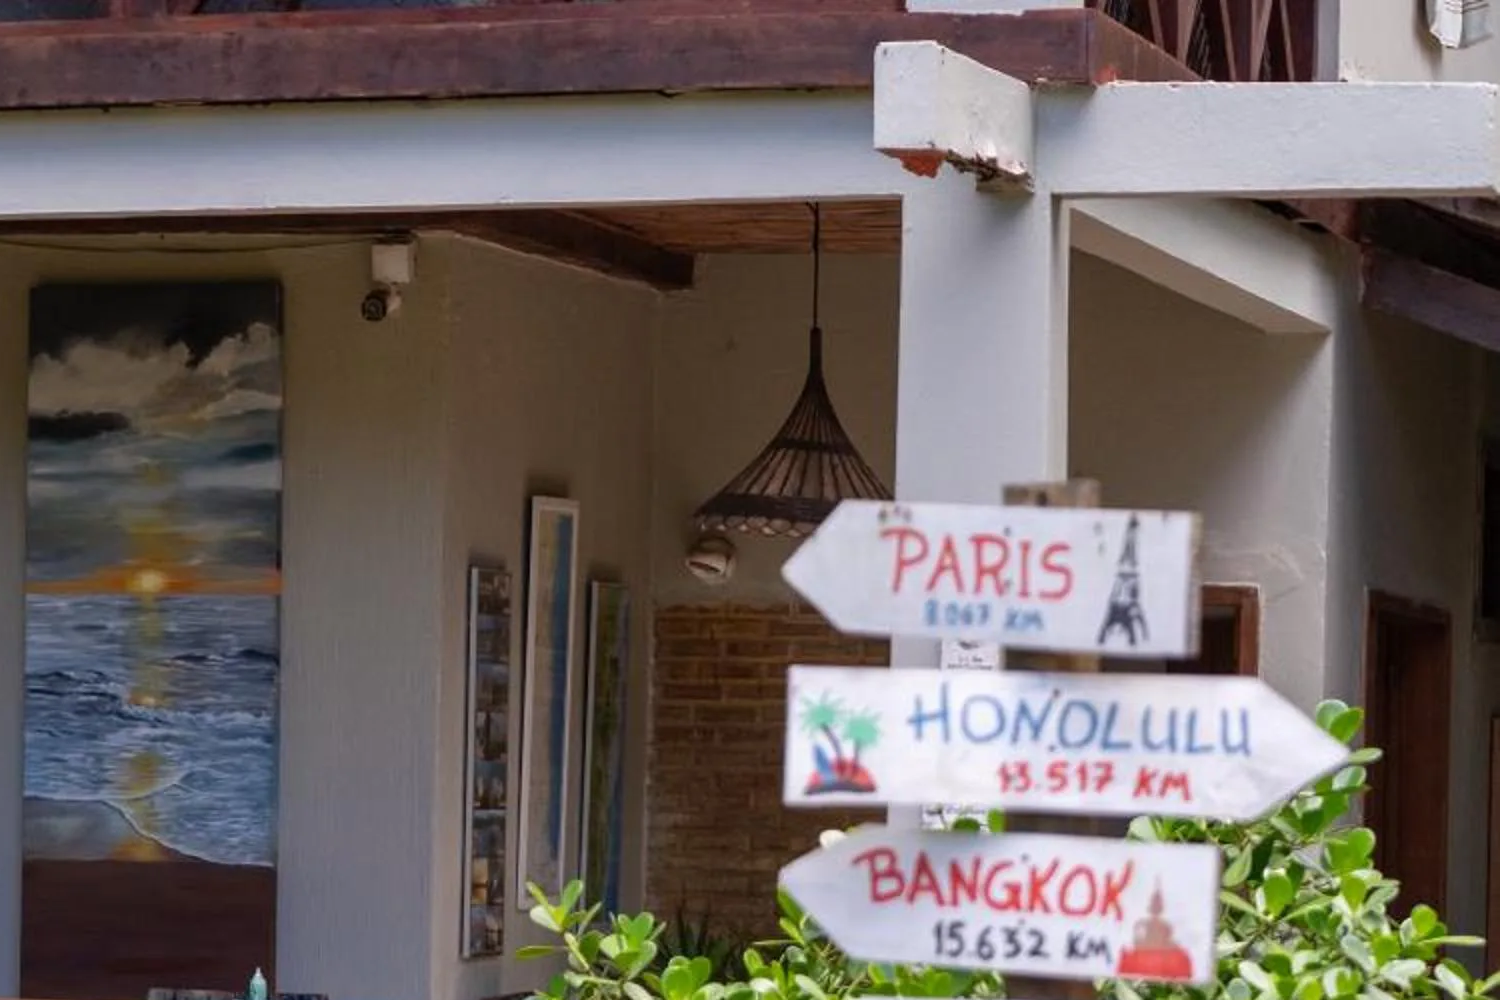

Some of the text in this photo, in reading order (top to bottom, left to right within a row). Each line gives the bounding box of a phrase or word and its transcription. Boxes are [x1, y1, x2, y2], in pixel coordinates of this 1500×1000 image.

[879, 525, 1075, 603] PARIS
[908, 682, 1252, 758] HONOLULU
[1132, 765, 1193, 803] KM
[852, 846, 1136, 923] BANGKOK
